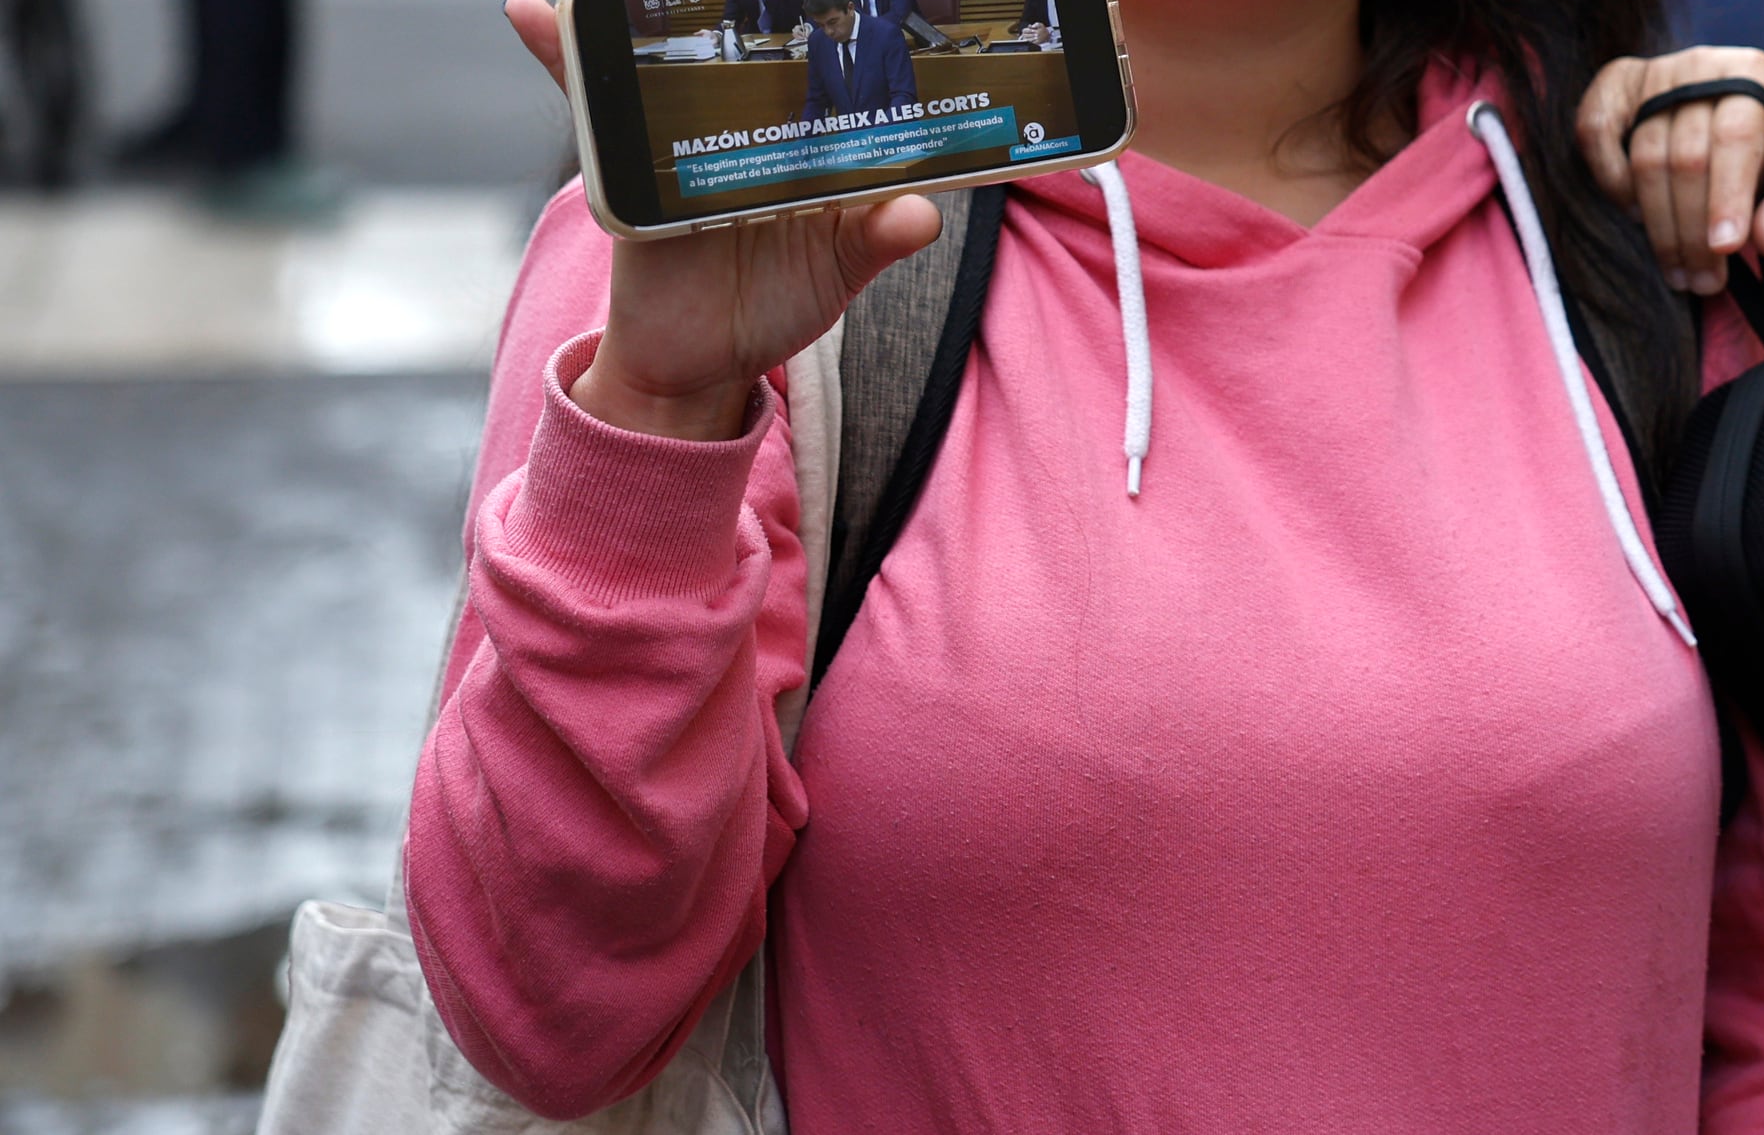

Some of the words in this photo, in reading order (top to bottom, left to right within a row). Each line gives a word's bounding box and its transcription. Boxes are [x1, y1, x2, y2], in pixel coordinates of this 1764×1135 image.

[673, 130, 750, 157] MAZÓN
[753, 111, 872, 143] COMPAREIX
[874, 108, 889, 124] A
[891, 102, 925, 122] LES
[927, 92, 991, 115] CORTS
[739, 148, 799, 168] preguntar-se
[801, 146, 808, 155] si
[809, 145, 818, 154] la
[820, 138, 859, 153] resposta
[860, 137, 867, 146] a
[929, 126, 941, 136] va
[942, 123, 957, 132] ser
[957, 115, 1004, 130] adequada
[689, 179, 696, 188] a
[697, 176, 706, 186] la
[707, 169, 748, 187] gravetat
[749, 167, 762, 177] de
[763, 166, 772, 176] la
[772, 160, 812, 175] situació,
[837, 150, 872, 163] sistema
[873, 146, 884, 157] hi
[884, 147, 896, 155] va
